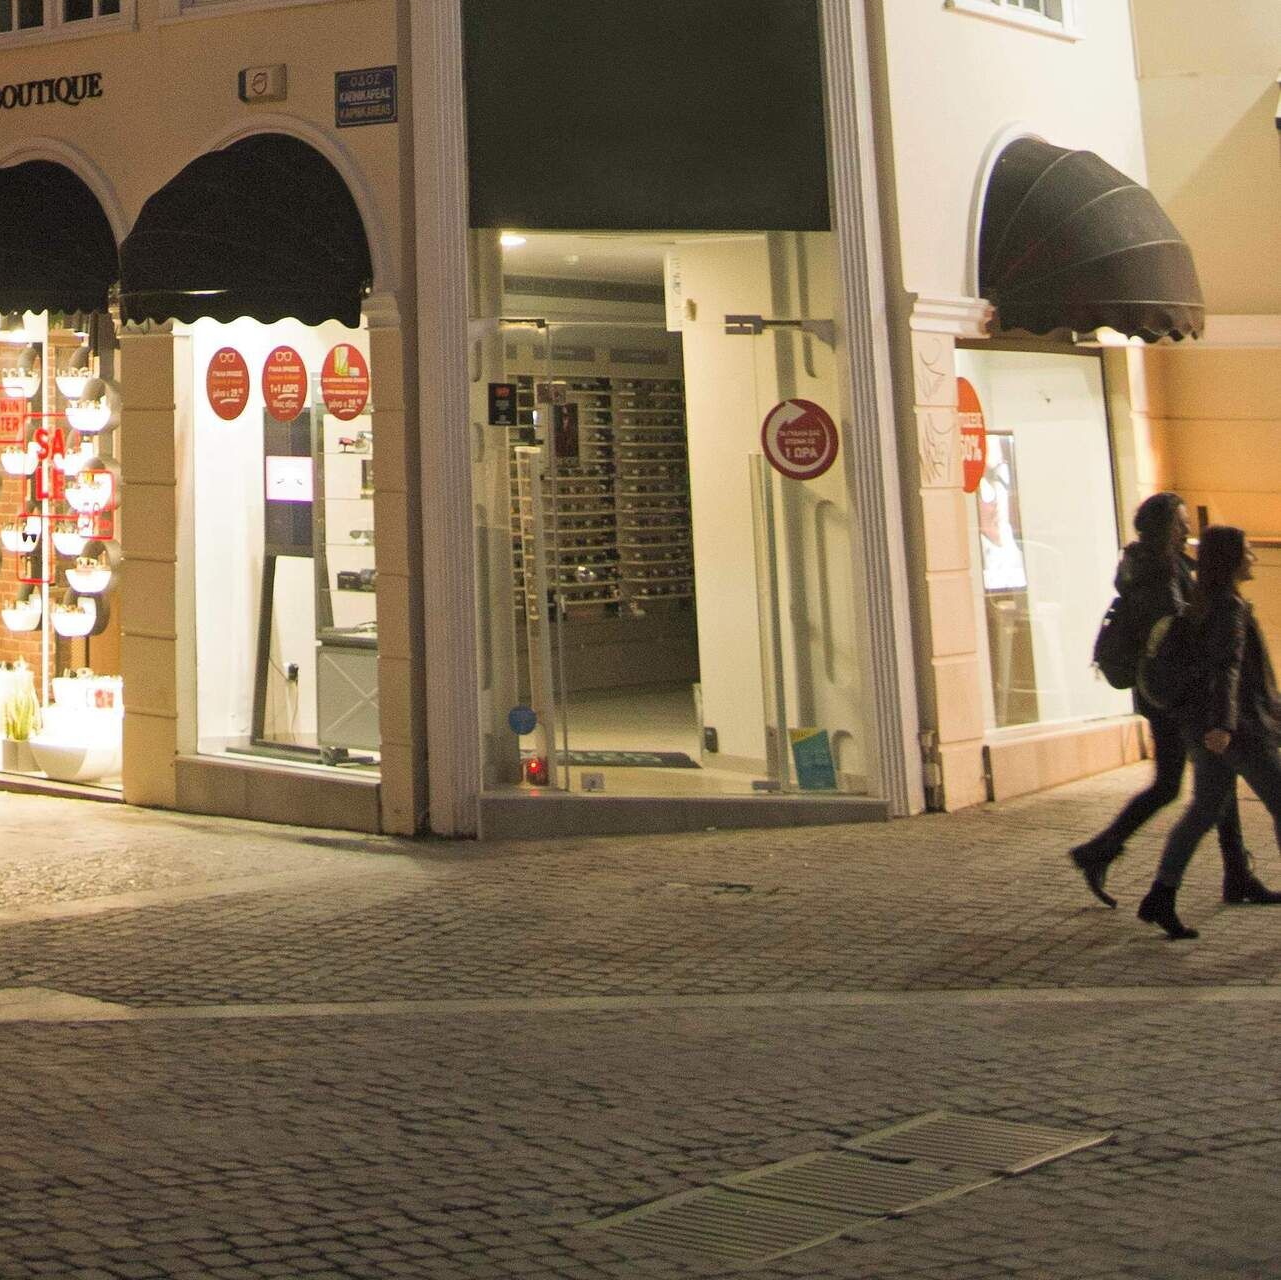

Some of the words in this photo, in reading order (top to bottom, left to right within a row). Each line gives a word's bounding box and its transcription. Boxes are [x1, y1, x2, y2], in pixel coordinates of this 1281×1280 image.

[350, 73, 381, 87] ΟΔΟΣ
[0, 399, 19, 411] WIN
[1, 417, 18, 431] TER
[35, 428, 65, 459] SA
